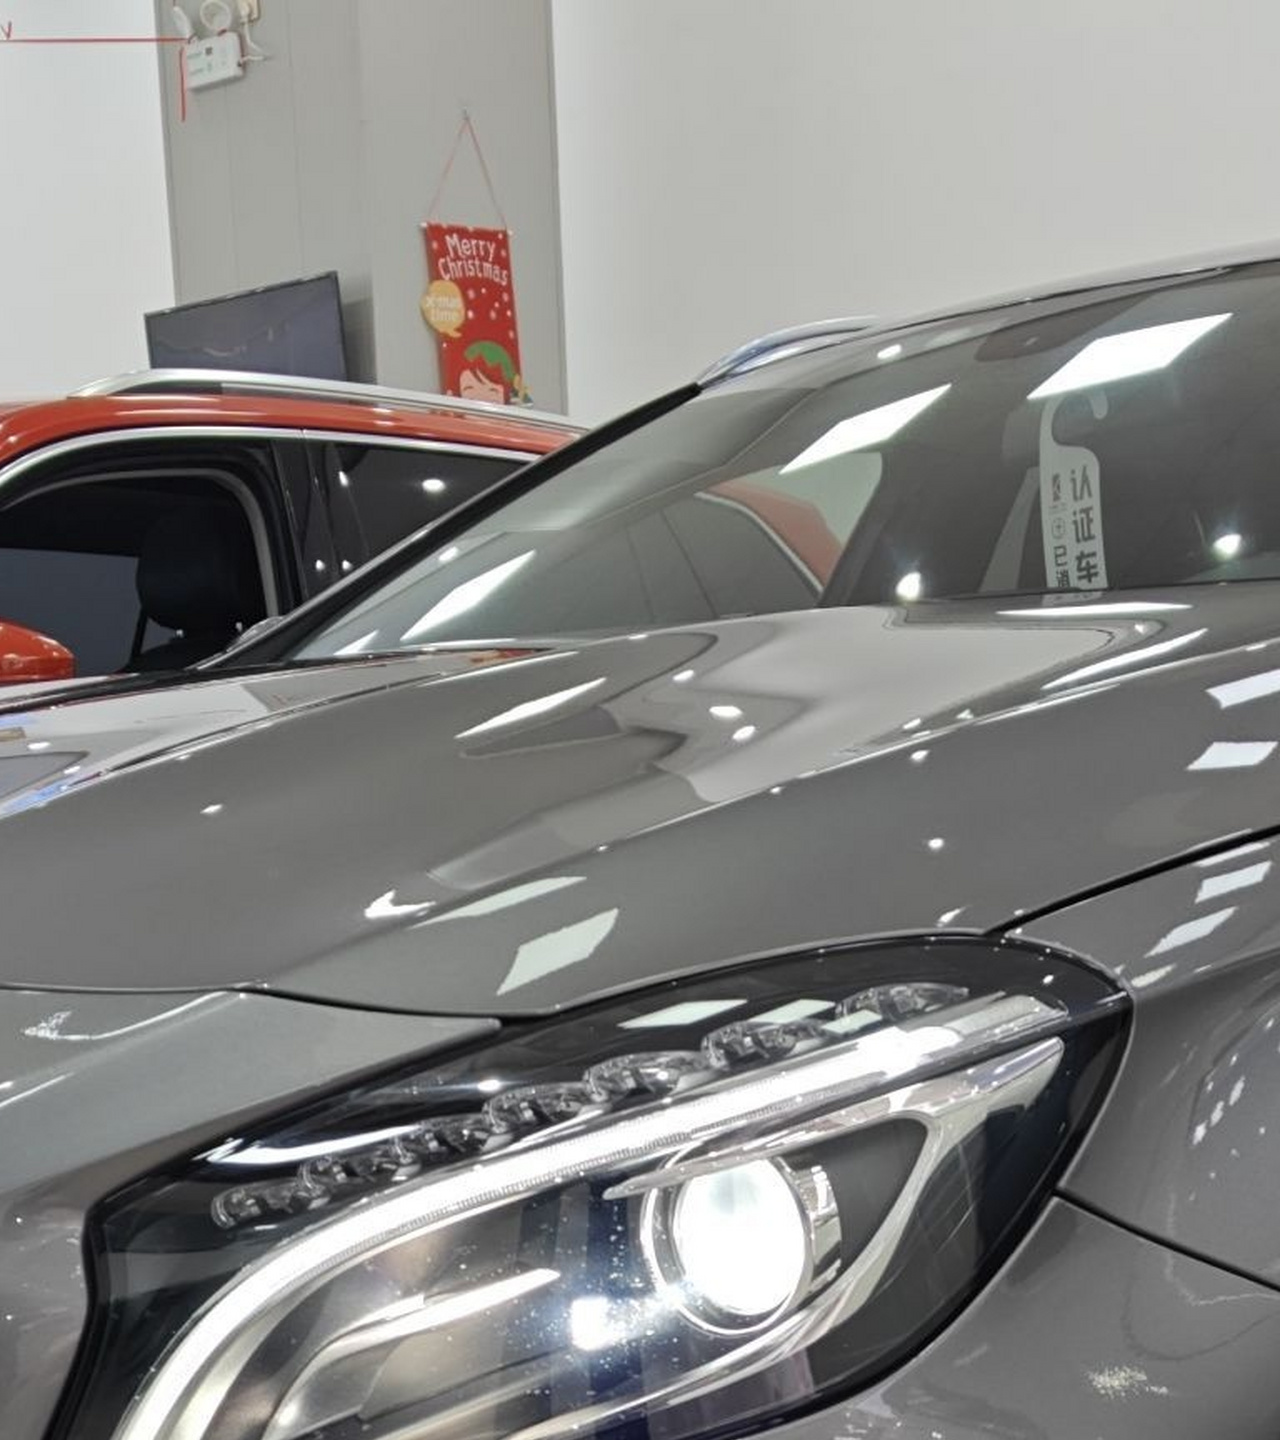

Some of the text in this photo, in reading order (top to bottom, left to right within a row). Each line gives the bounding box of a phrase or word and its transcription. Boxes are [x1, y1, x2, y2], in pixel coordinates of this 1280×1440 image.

[445, 233, 496, 262] Merry
[438, 257, 508, 285] Christmas
[1070, 465, 1100, 584] 认证车
